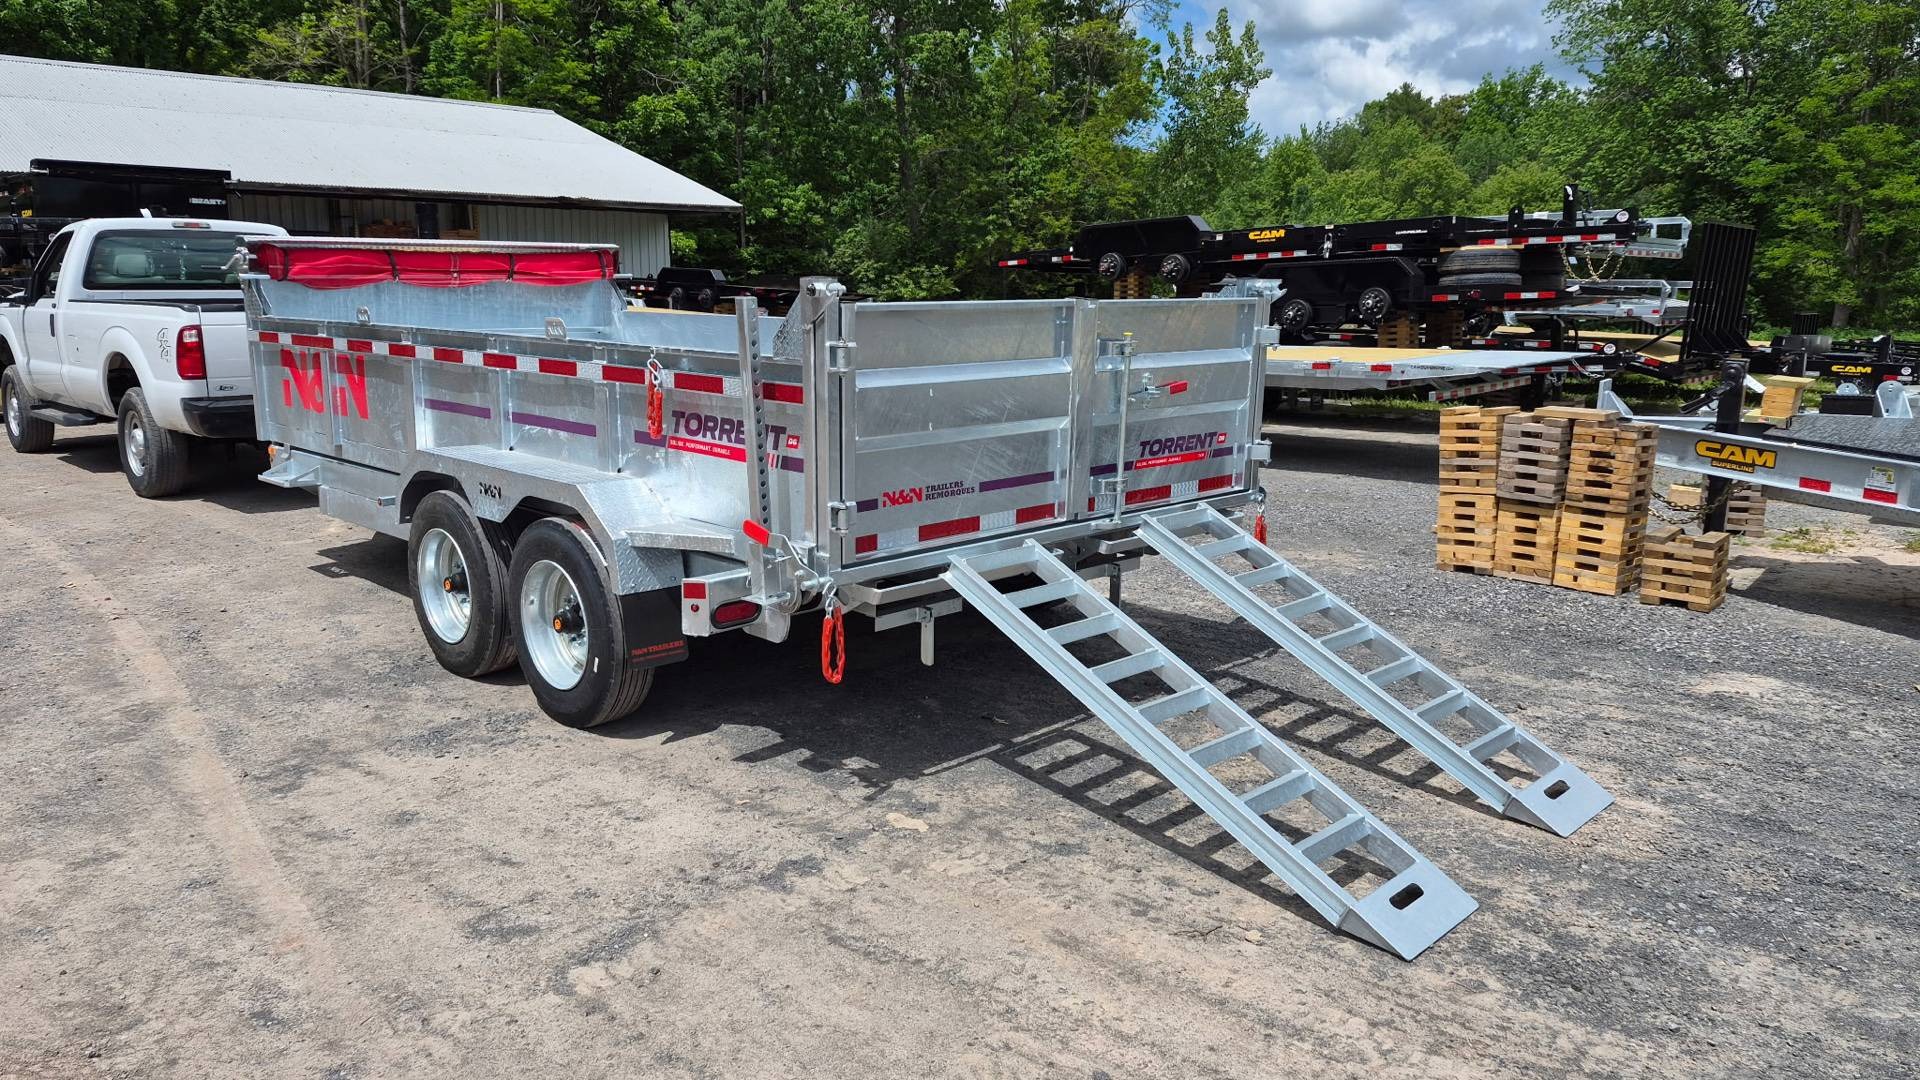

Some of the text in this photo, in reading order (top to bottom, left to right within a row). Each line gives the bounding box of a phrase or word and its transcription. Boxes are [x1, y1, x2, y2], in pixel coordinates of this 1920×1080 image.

[1249, 229, 1286, 240] CAM
[1831, 364, 1873, 374] CAM
[1140, 432, 1218, 457] TORRENT
[1695, 440, 1777, 468] CAM
[1712, 460, 1755, 473] SUPERLINE
[882, 480, 964, 508] N&N TRAILERS
[925, 486, 975, 501] REMORQUES
